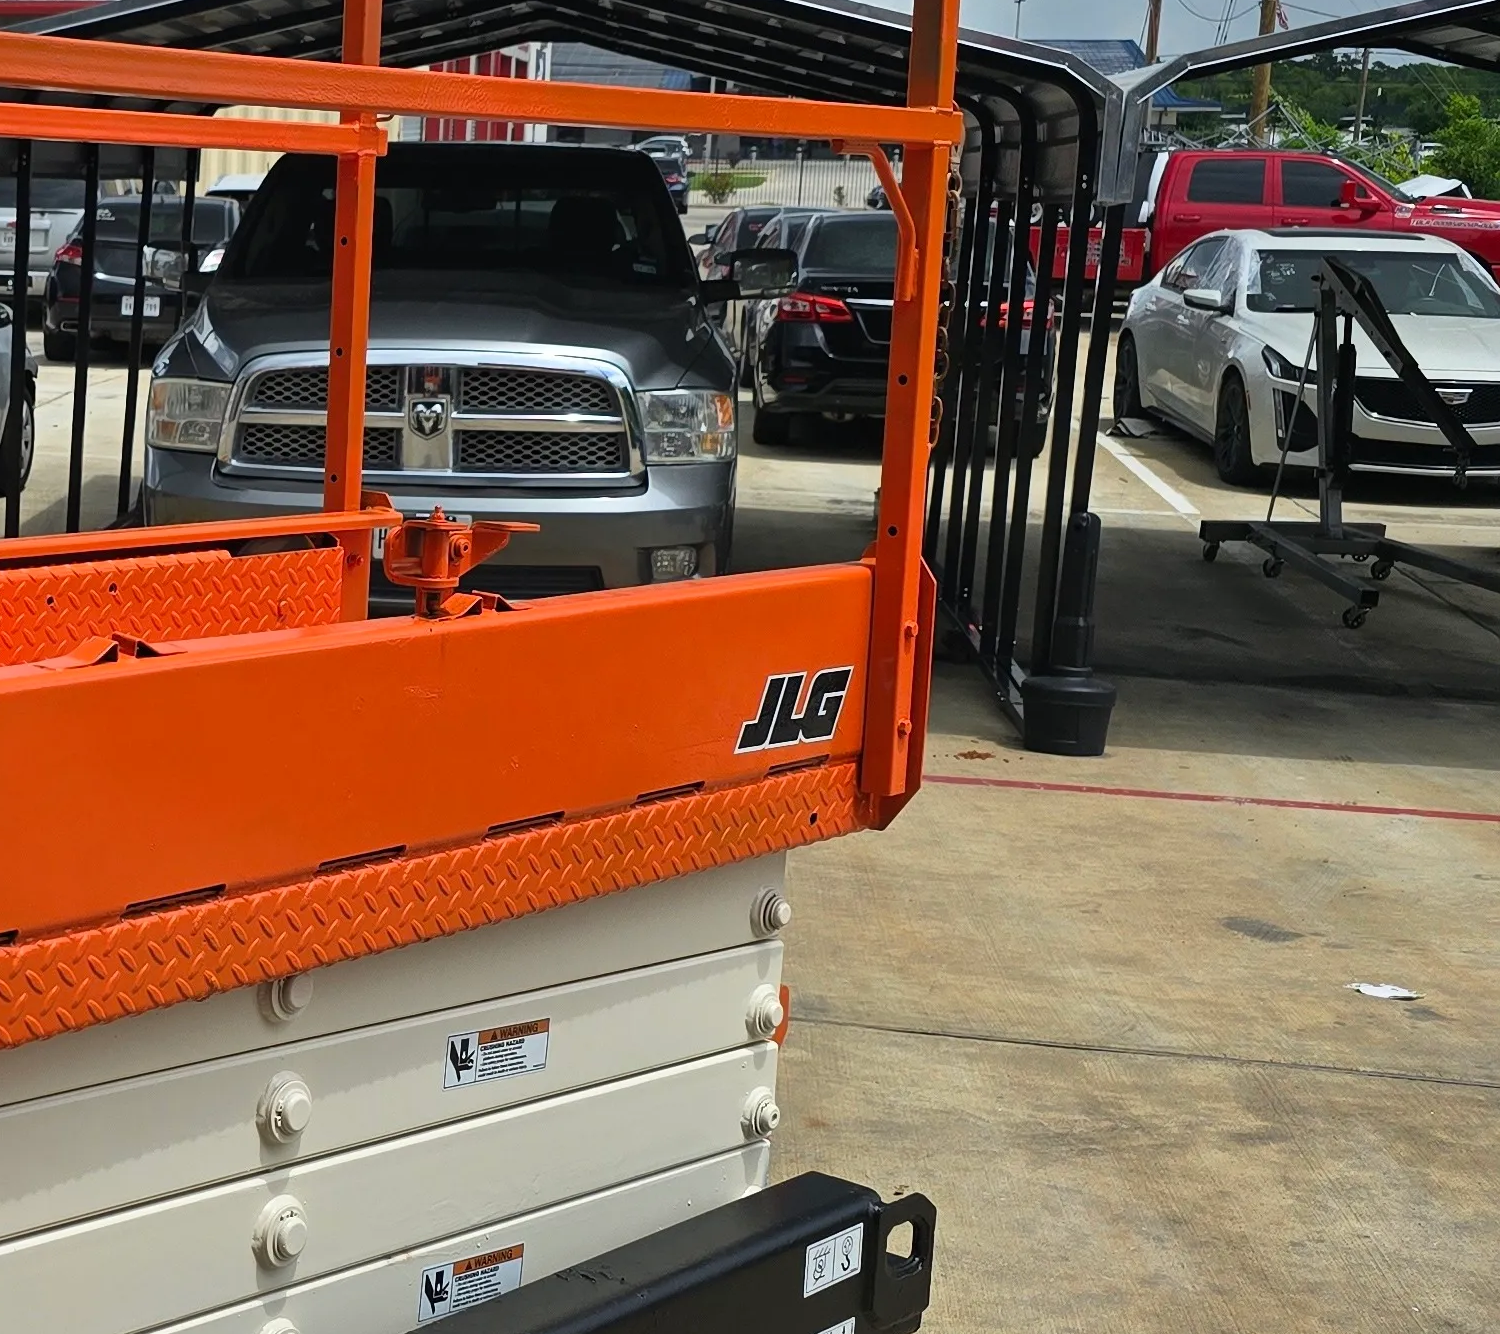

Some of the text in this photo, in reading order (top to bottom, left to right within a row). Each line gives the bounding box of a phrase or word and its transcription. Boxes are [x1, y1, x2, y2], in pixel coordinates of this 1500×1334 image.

[734, 665, 854, 754] JLG
[500, 1022, 538, 1038] WARNING
[474, 1249, 513, 1267] WARNING
